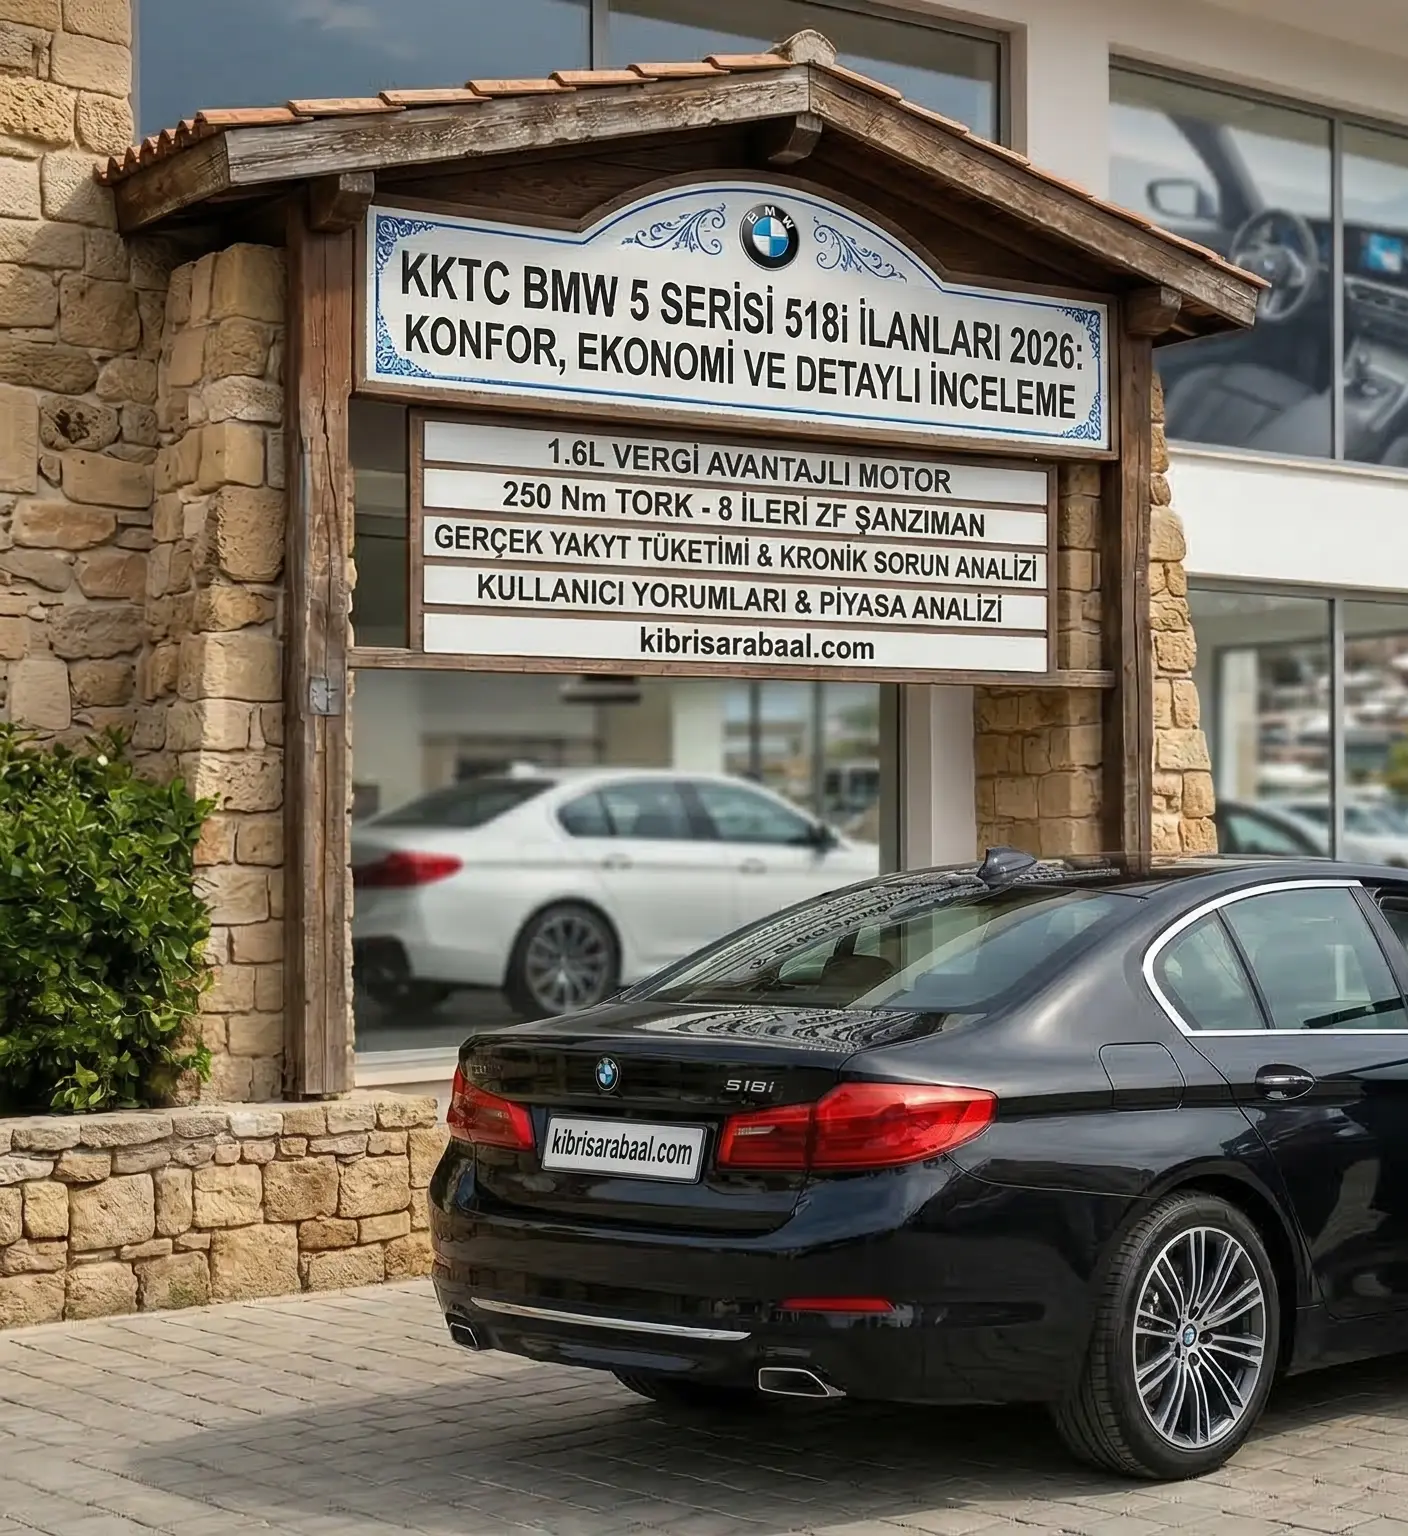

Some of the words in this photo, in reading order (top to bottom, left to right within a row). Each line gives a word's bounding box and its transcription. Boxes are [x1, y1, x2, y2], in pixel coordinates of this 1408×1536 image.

[401, 249, 510, 306] KKTC
[523, 265, 619, 318] BMW
[630, 279, 650, 322] 5
[660, 280, 774, 335] SERİSİ
[785, 297, 848, 344] 518i
[859, 297, 1001, 362] İLANLARI
[1009, 326, 1084, 371] 2026:
[405, 313, 566, 376] KONFOR,
[577, 331, 734, 385] EKONOMİ
[743, 349, 787, 391] VE
[796, 355, 921, 404] DETAYLI
[930, 360, 1076, 420] İNCELEME
[548, 437, 605, 468] 1.6L
[612, 443, 699, 475] VERGİ
[706, 450, 850, 487] AVANTAJLI
[859, 463, 952, 494] MOTOR
[502, 480, 551, 510] 250
[561, 484, 606, 513] Nm
[615, 488, 694, 518] TORK
[701, 506, 711, 514] -
[717, 495, 733, 521] 8
[741, 491, 808, 526] İLERİ
[815, 503, 847, 528] ZF
[855, 505, 985, 538] ŞANZIMAN
[434, 524, 543, 559] GERÇEK
[549, 531, 632, 560] YAKYT
[637, 532, 749, 566] TÜKETİMİ
[756, 544, 773, 568] &
[780, 543, 868, 573] KRONİK
[873, 550, 949, 577] SORUN
[955, 553, 1037, 582] ANALİZİ
[477, 573, 624, 606] KULLANICI
[632, 581, 786, 613] YORUMLARI
[794, 589, 812, 614] &
[820, 585, 907, 619] PİYASA
[911, 594, 1002, 623] ANALİZİ
[640, 626, 875, 660] kibrisarabaal.com
[725, 1079, 775, 1093] 518i
[551, 1128, 693, 1165] kibrisarabaal.com
